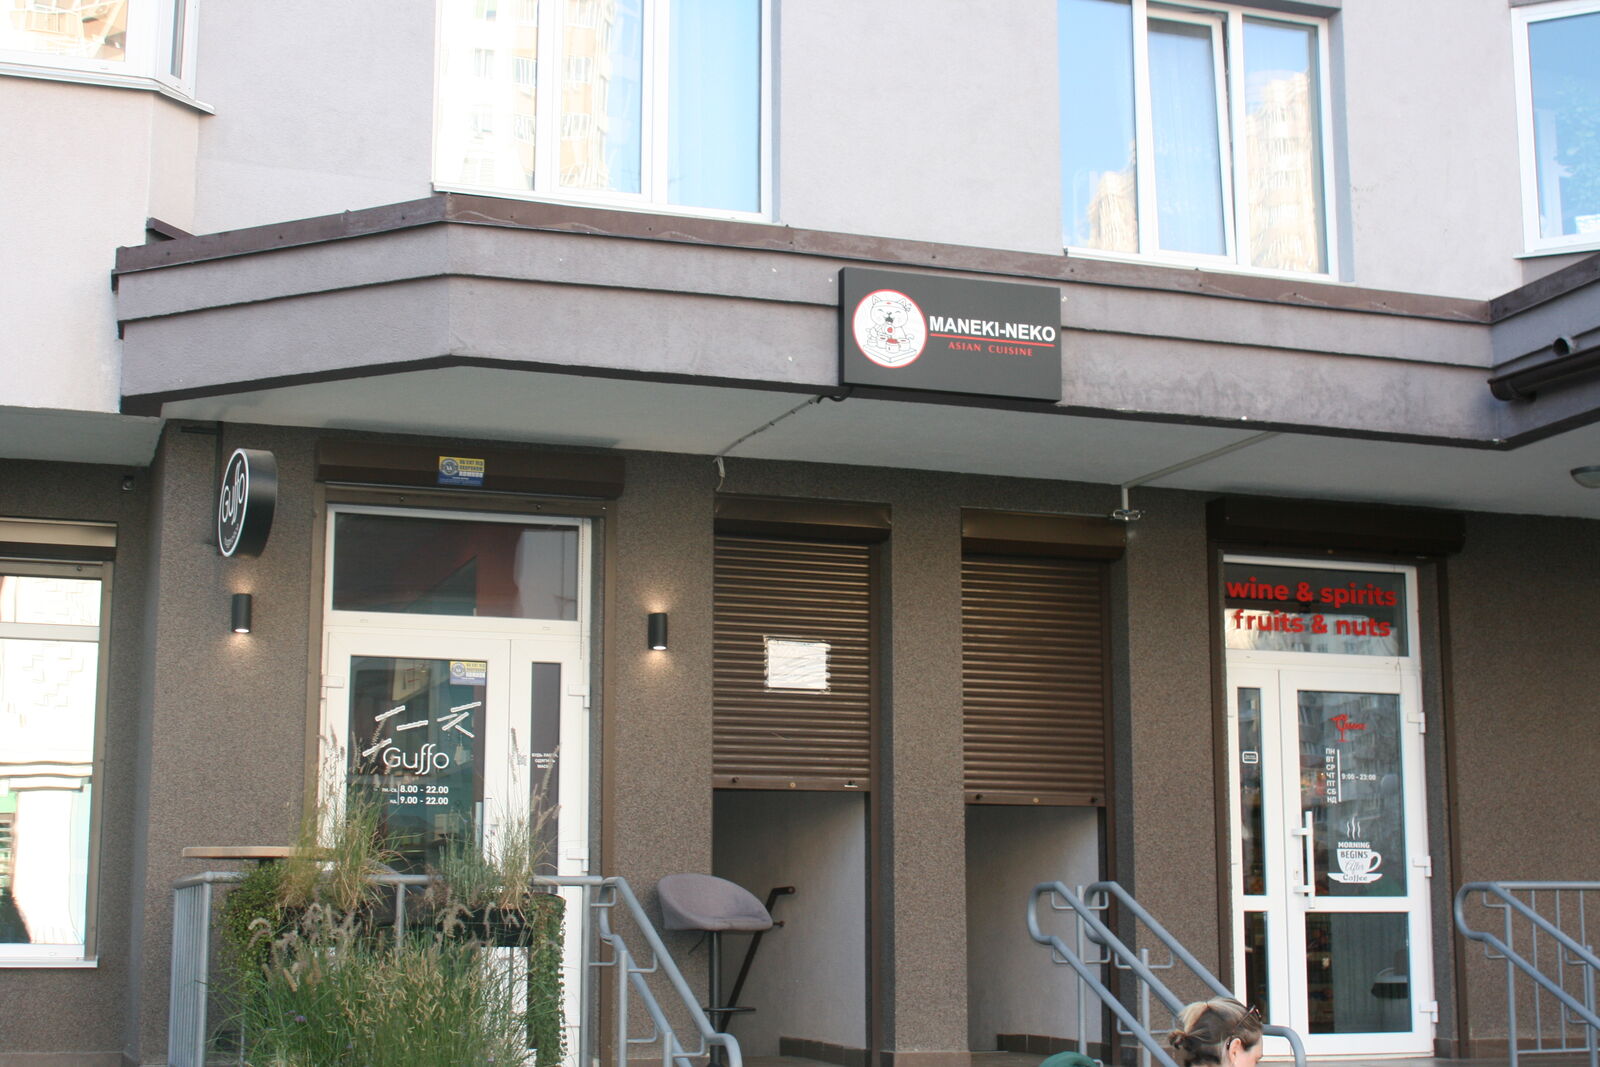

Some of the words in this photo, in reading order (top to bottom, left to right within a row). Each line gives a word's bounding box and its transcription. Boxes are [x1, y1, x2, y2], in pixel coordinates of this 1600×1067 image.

[929, 315, 1056, 342] MANEKI-NEKO
[948, 341, 982, 352] ASIAN
[988, 344, 1033, 357] CUISINE
[1227, 576, 1290, 600] wine
[1296, 581, 1313, 602] &
[1320, 582, 1397, 608] spirits
[1234, 609, 1305, 633] fruits
[1311, 614, 1328, 634] &
[1336, 617, 1392, 637] nuts
[382, 743, 450, 775] Guffo
[400, 785, 418, 793] 8.00
[425, 785, 449, 794] 22.00
[400, 796, 418, 804] 9.00
[425, 797, 449, 805] 22.00
[1340, 850, 1368, 859] BEGINS
[1342, 874, 1368, 882] Coffee
